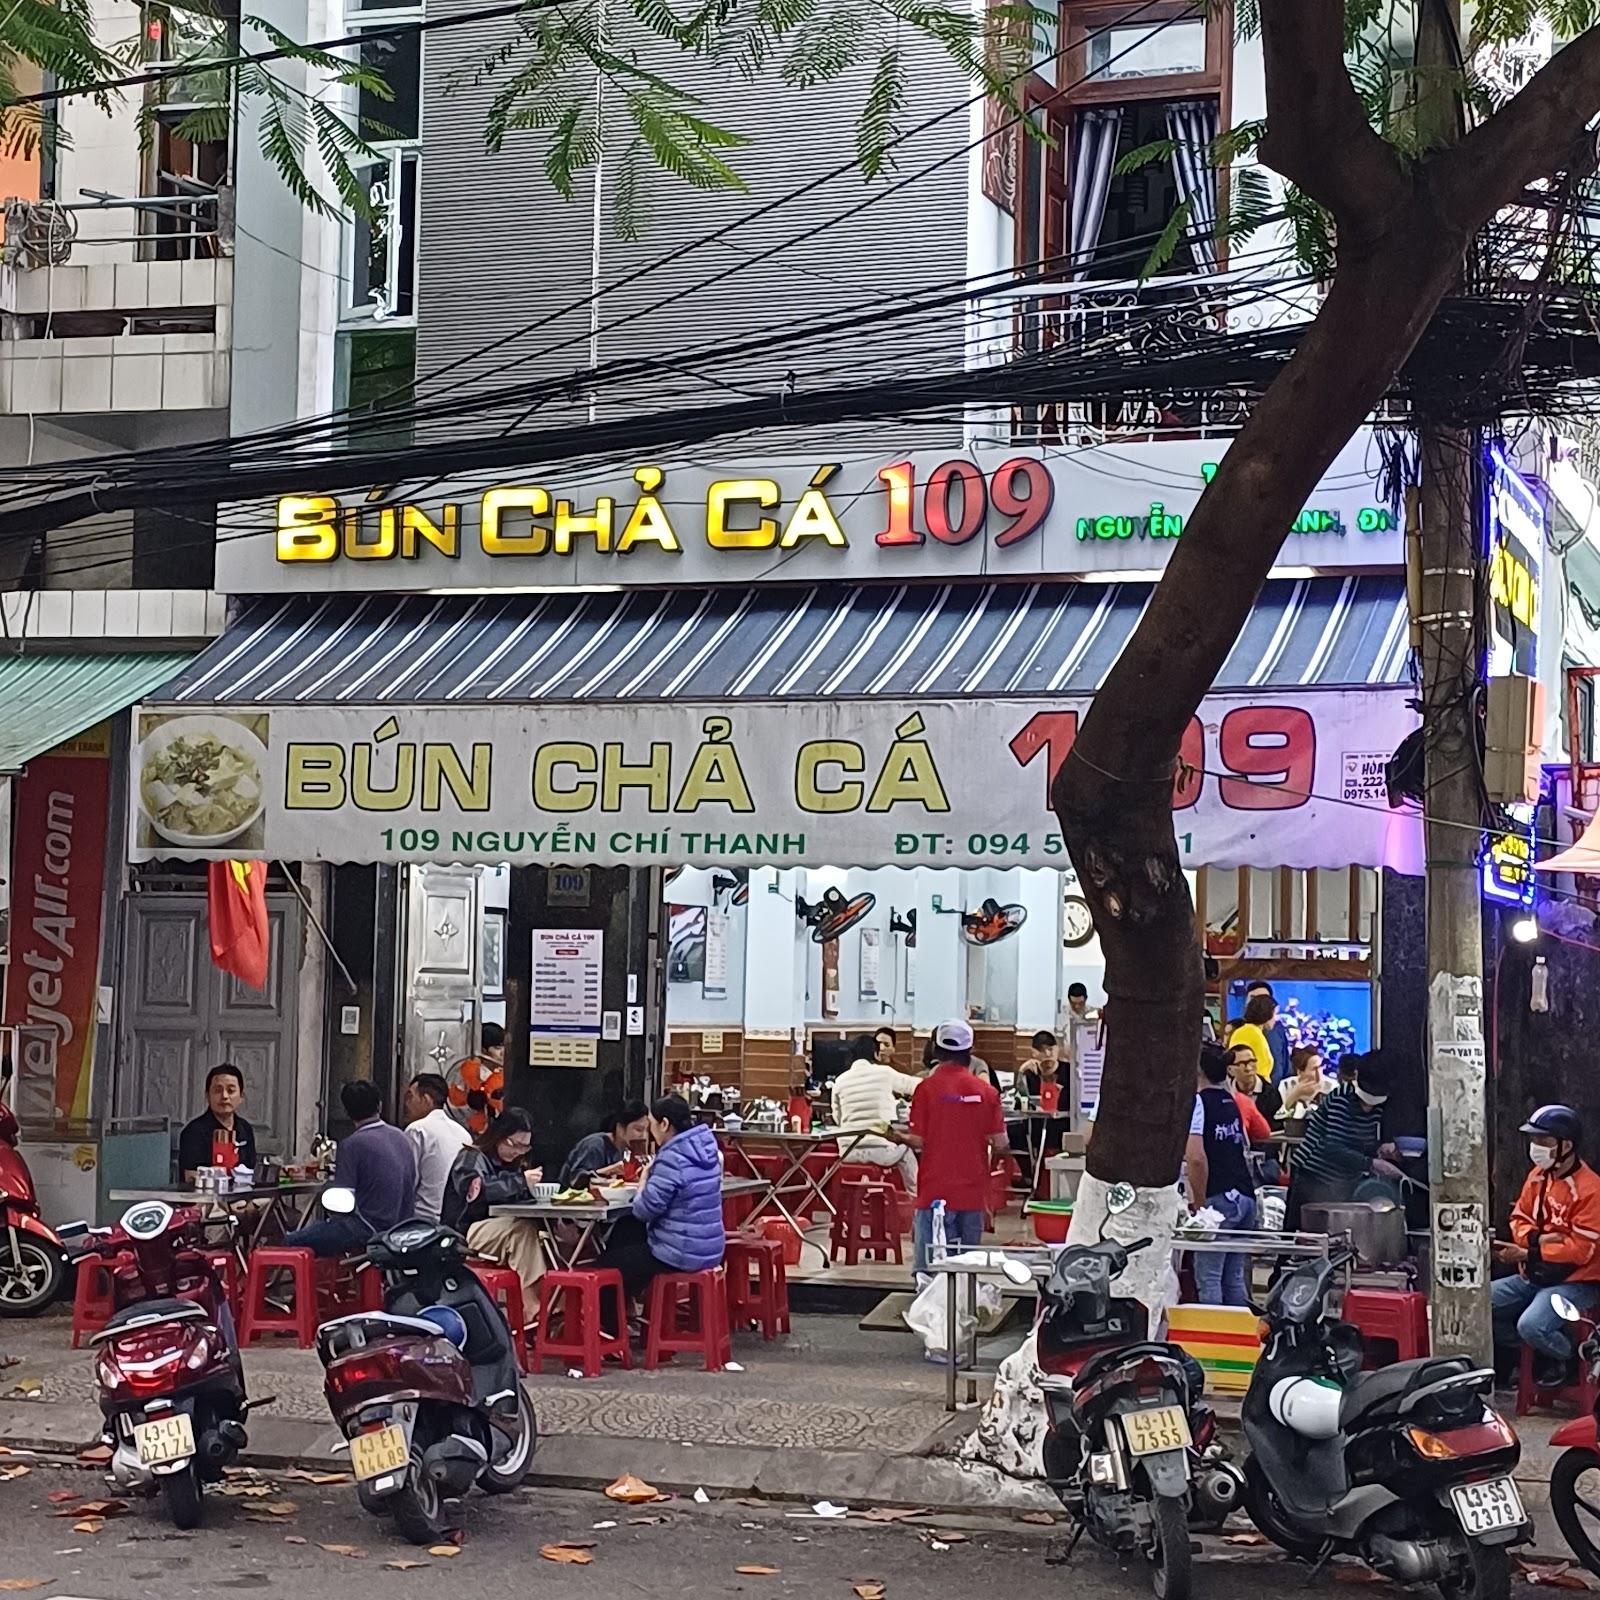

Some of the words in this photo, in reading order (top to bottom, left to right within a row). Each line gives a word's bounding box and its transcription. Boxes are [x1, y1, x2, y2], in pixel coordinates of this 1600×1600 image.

[276, 484, 459, 563] BÚN
[481, 467, 682, 557] CHẢ
[706, 462, 849, 552] CÁ
[876, 456, 1055, 547] 109
[1076, 502, 1182, 541] NGUYỄN
[284, 715, 492, 811] BÚN
[532, 716, 755, 813] CHẢ
[795, 711, 950, 813] CÁ
[380, 828, 440, 851] 109
[452, 822, 596, 853] NGUYỄN
[609, 828, 669, 854] CHÍ
[681, 832, 806, 855] THANH
[894, 833, 953, 854] ĐT:
[968, 833, 1030, 855] 094
[1137, 1428, 1182, 1451] 7555
[1471, 1503, 1515, 1529] 2379
